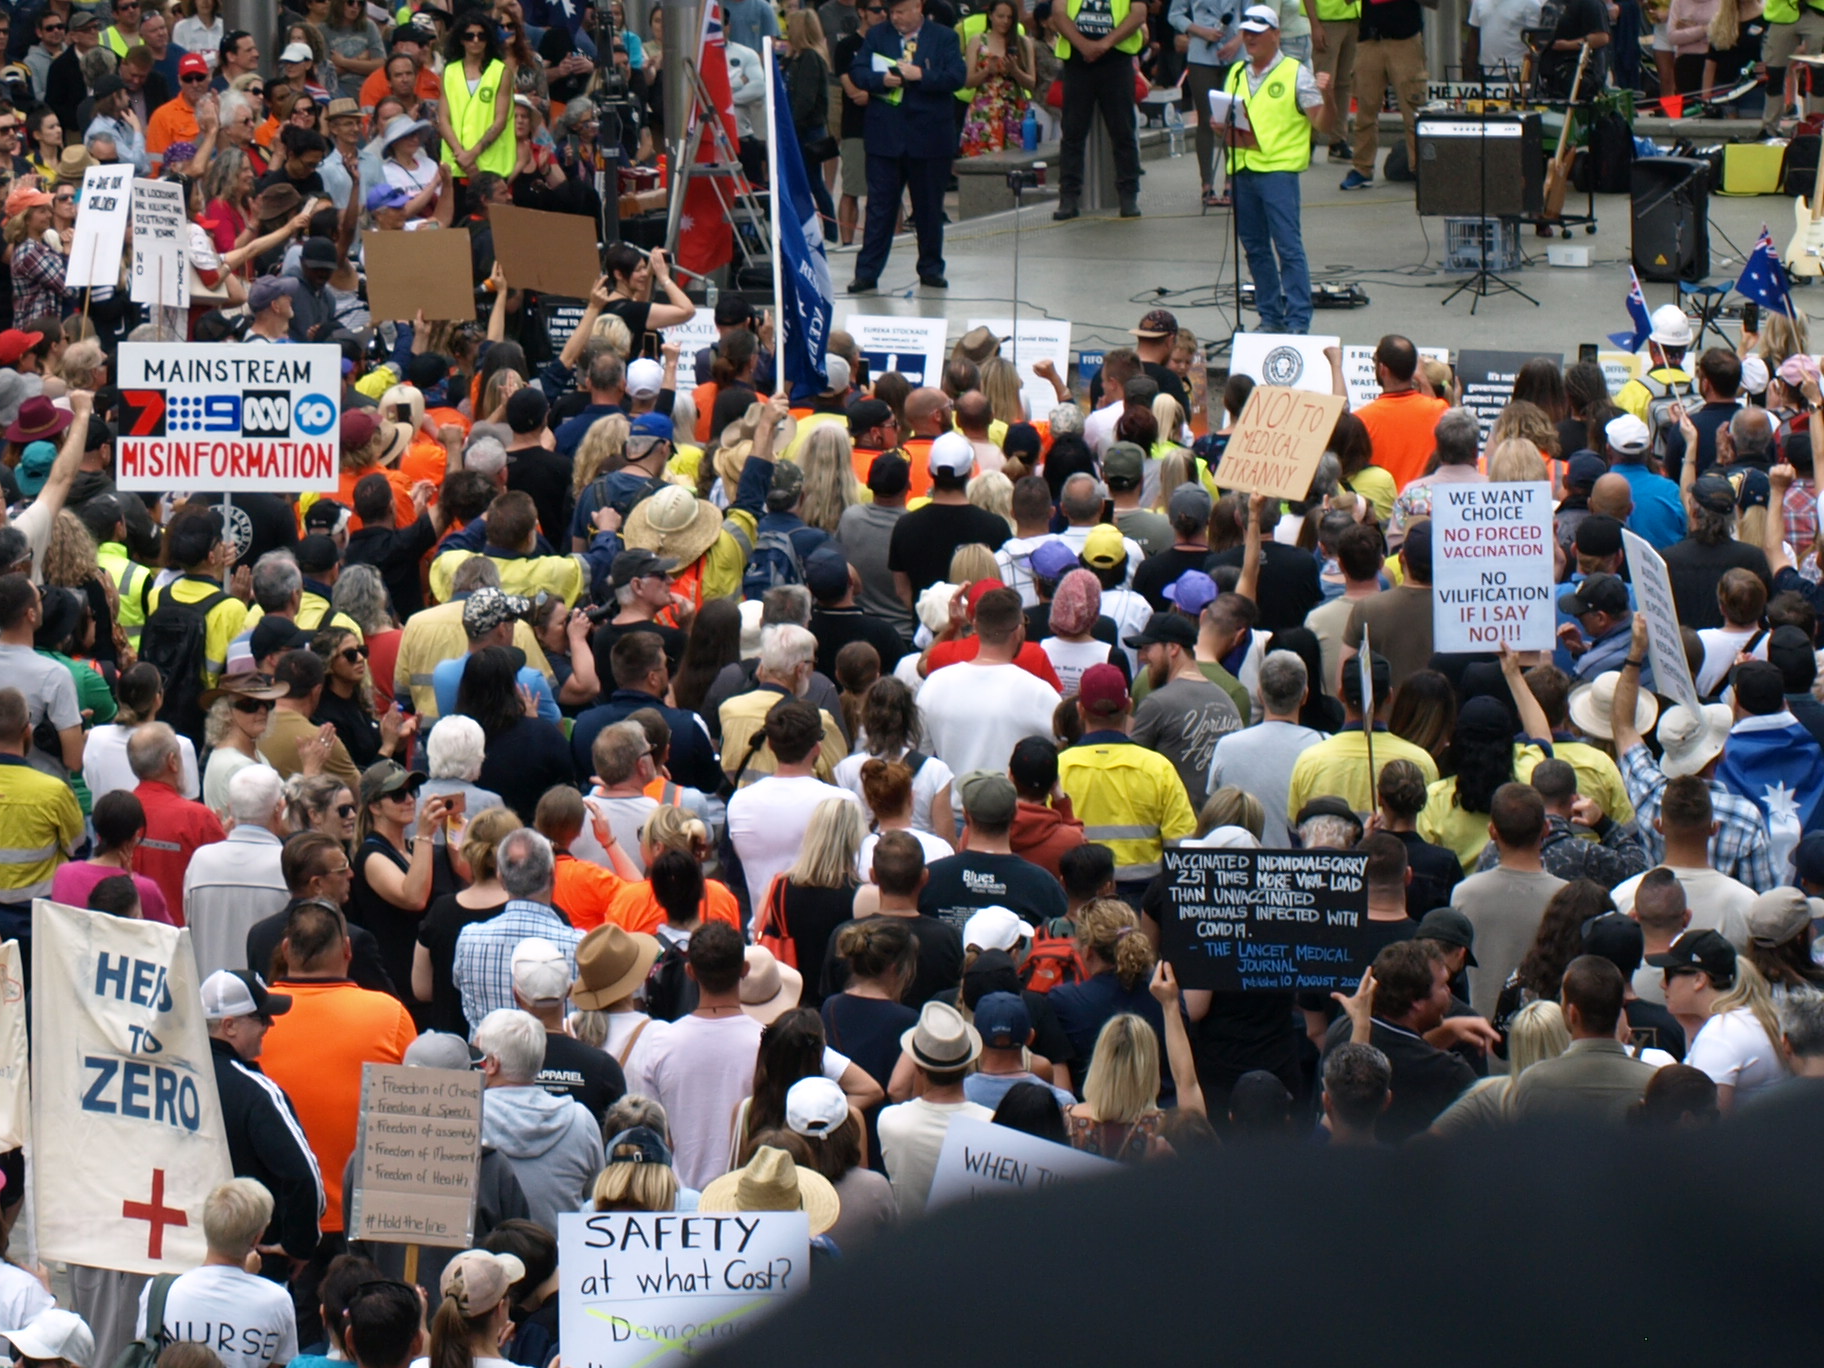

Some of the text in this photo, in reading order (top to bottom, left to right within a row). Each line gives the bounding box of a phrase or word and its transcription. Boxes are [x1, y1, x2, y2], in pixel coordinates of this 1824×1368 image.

[144, 359, 311, 383] MAINSTREAM
[122, 390, 166, 436] 7
[1243, 391, 1324, 432] NO! TO
[1238, 430, 1301, 460] MEDICAL
[122, 442, 333, 478] MISINFORMATION
[1220, 456, 1298, 490] TYRANNY
[1449, 490, 1534, 505] WE WANT
[1461, 506, 1523, 521] CHOICE
[1444, 526, 1542, 542] NO FORCED
[1444, 544, 1543, 558] VACCINATION
[1481, 572, 1506, 585] NO
[1439, 586, 1549, 603] VILIFICATION
[1460, 605, 1529, 622] IF I SAY
[1469, 625, 1521, 642] NO!!!
[1164, 852, 1369, 877] VACCINATED INDIVIDUALS CARRY
[963, 870, 995, 883] Blues
[1215, 871, 1362, 892] TIMES MORE VIRAL LOAD
[1169, 887, 1315, 906] THAN UNVACCINATED
[1179, 905, 1358, 927] INDIVIDUALS INFECTED WITH
[1204, 941, 1353, 962] THE LANCET MEDICAL
[1237, 959, 1298, 972] JOURNAL
[1296, 976, 1336, 987] AUGUST
[82, 1056, 200, 1131] ZERO
[383, 1076, 429, 1094] Freedom
[378, 1099, 471, 1118] Freedom Speech
[377, 1120, 476, 1146] Freedom assembly
[375, 1142, 414, 1157] Freedom
[375, 1163, 412, 1180] Freedom
[965, 1146, 1028, 1185] WHEN
[585, 1215, 760, 1253] SAFETY
[581, 1256, 792, 1295] at what Cost?
[161, 1321, 279, 1360] NURSE
